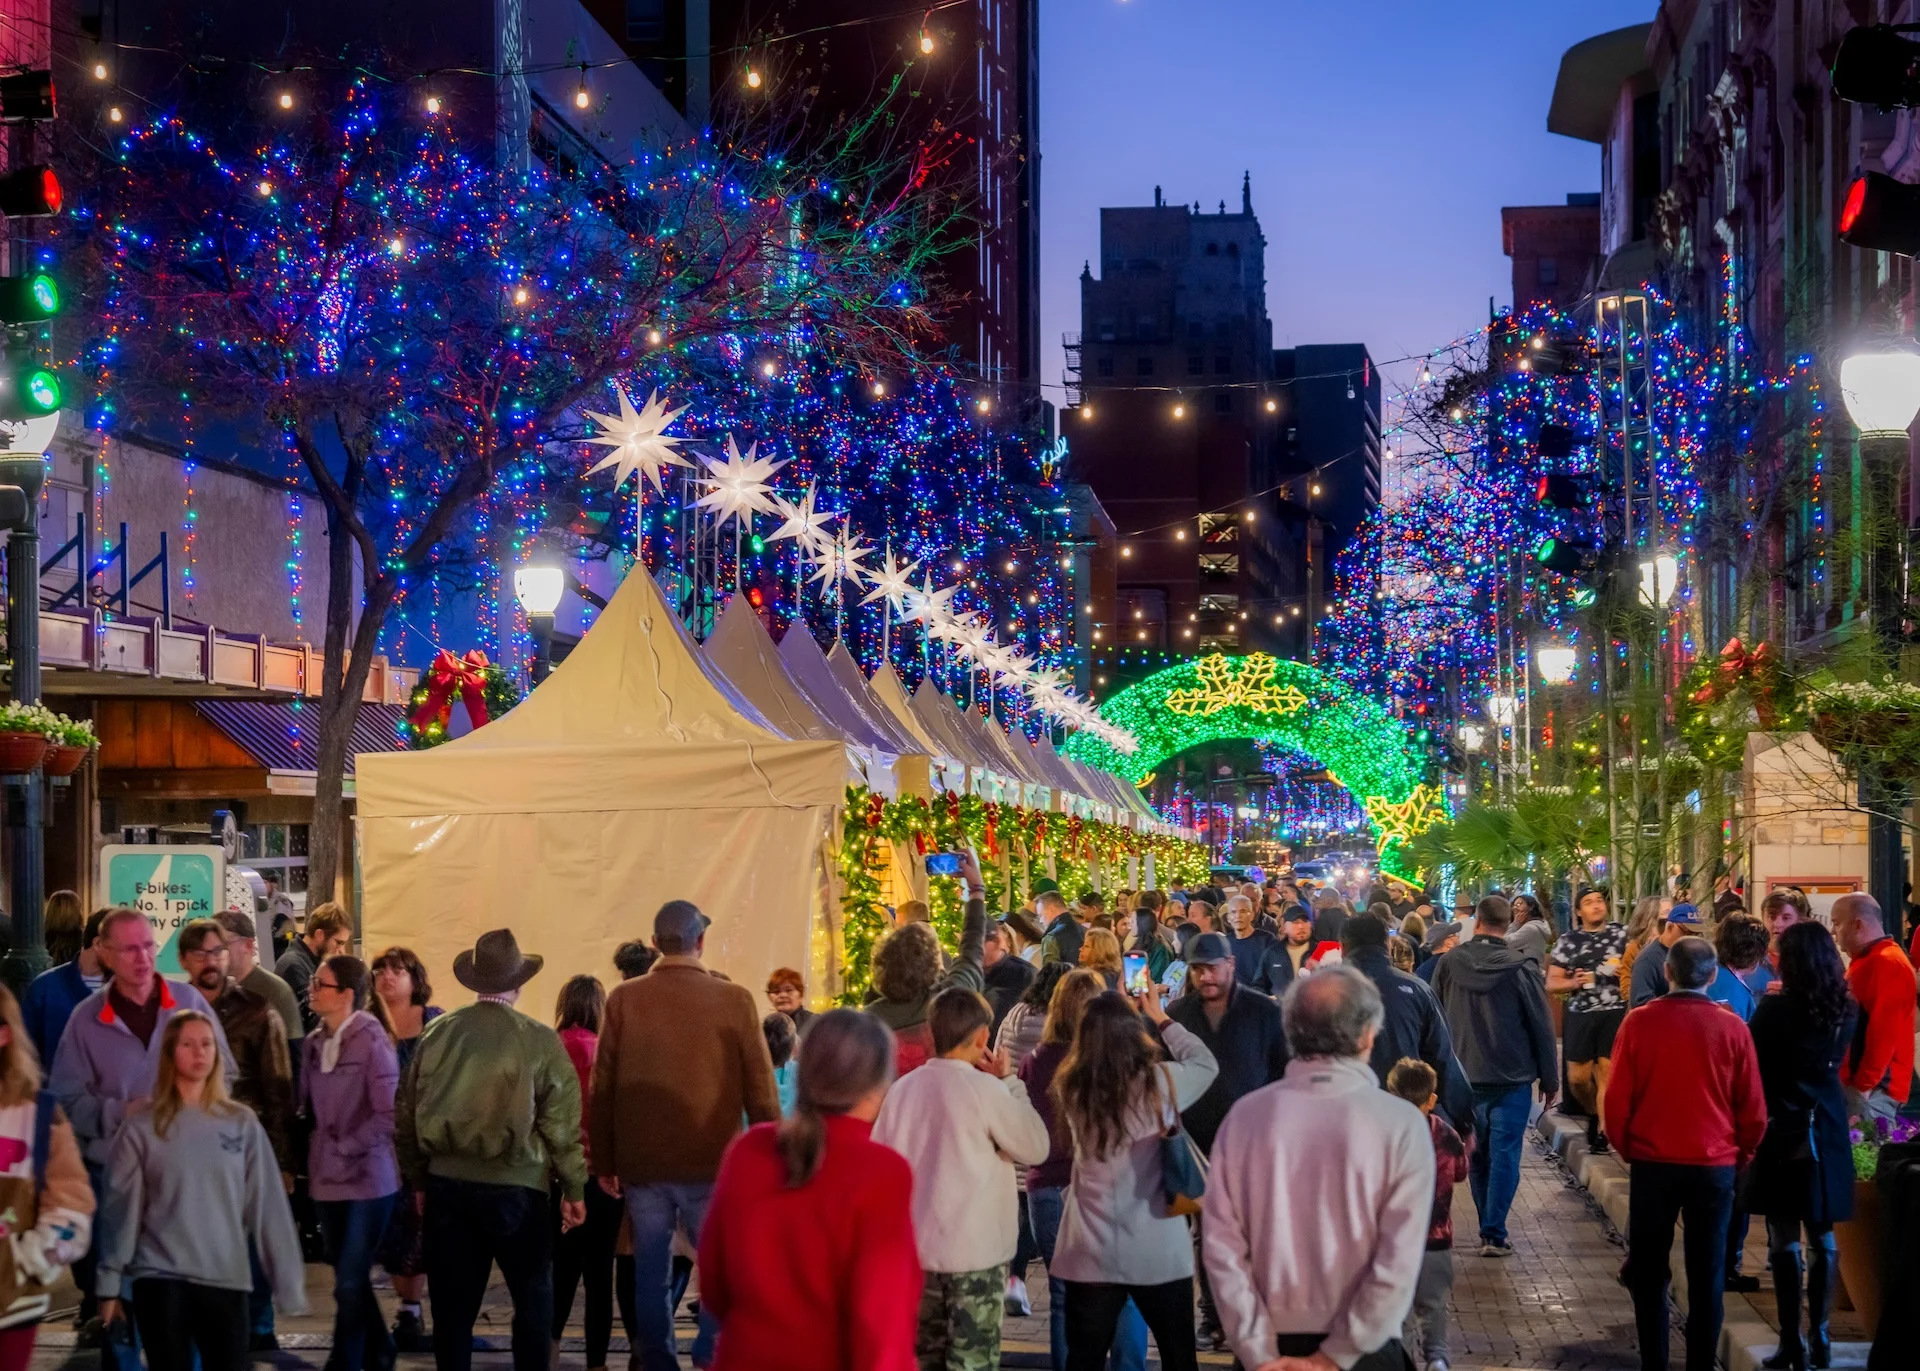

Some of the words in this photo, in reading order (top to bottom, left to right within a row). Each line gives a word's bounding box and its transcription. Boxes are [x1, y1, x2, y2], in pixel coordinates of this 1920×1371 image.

[135, 882, 191, 894] E-bikes:
[133, 899, 158, 911] No.
[165, 899, 169, 910] 1
[176, 899, 209, 913] pick
